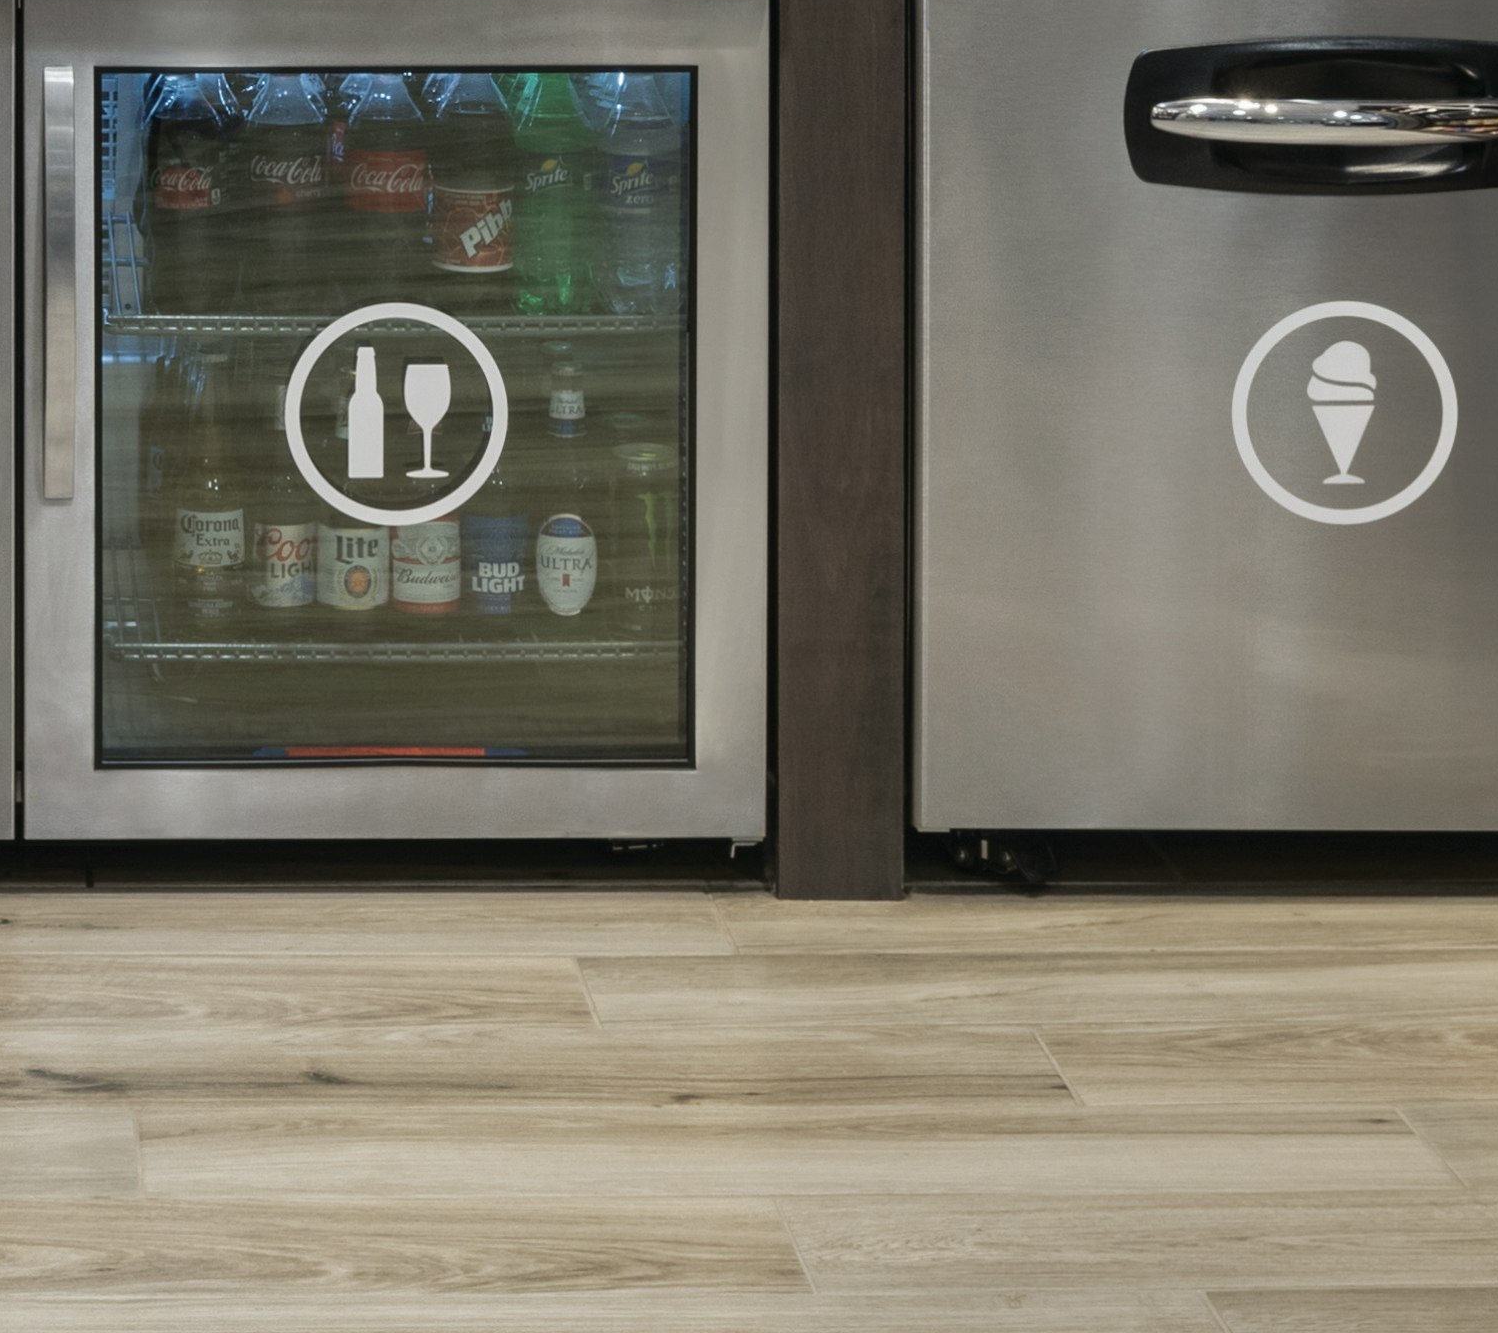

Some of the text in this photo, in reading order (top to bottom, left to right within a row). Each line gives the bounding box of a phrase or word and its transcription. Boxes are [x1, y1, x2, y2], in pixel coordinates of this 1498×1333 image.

[250, 155, 323, 185] Coca-Cola
[351, 164, 425, 194] Coca-Cola
[524, 161, 570, 192] Sprite
[611, 167, 655, 195] Sprite
[625, 193, 656, 205] zero
[179, 512, 241, 537] Corona
[196, 533, 230, 548] Extra
[335, 535, 380, 565] Lite
[270, 561, 316, 581] LIGH
[478, 561, 520, 578] BUD
[540, 556, 594, 572] ULTRA
[471, 575, 526, 595] LIGHT
